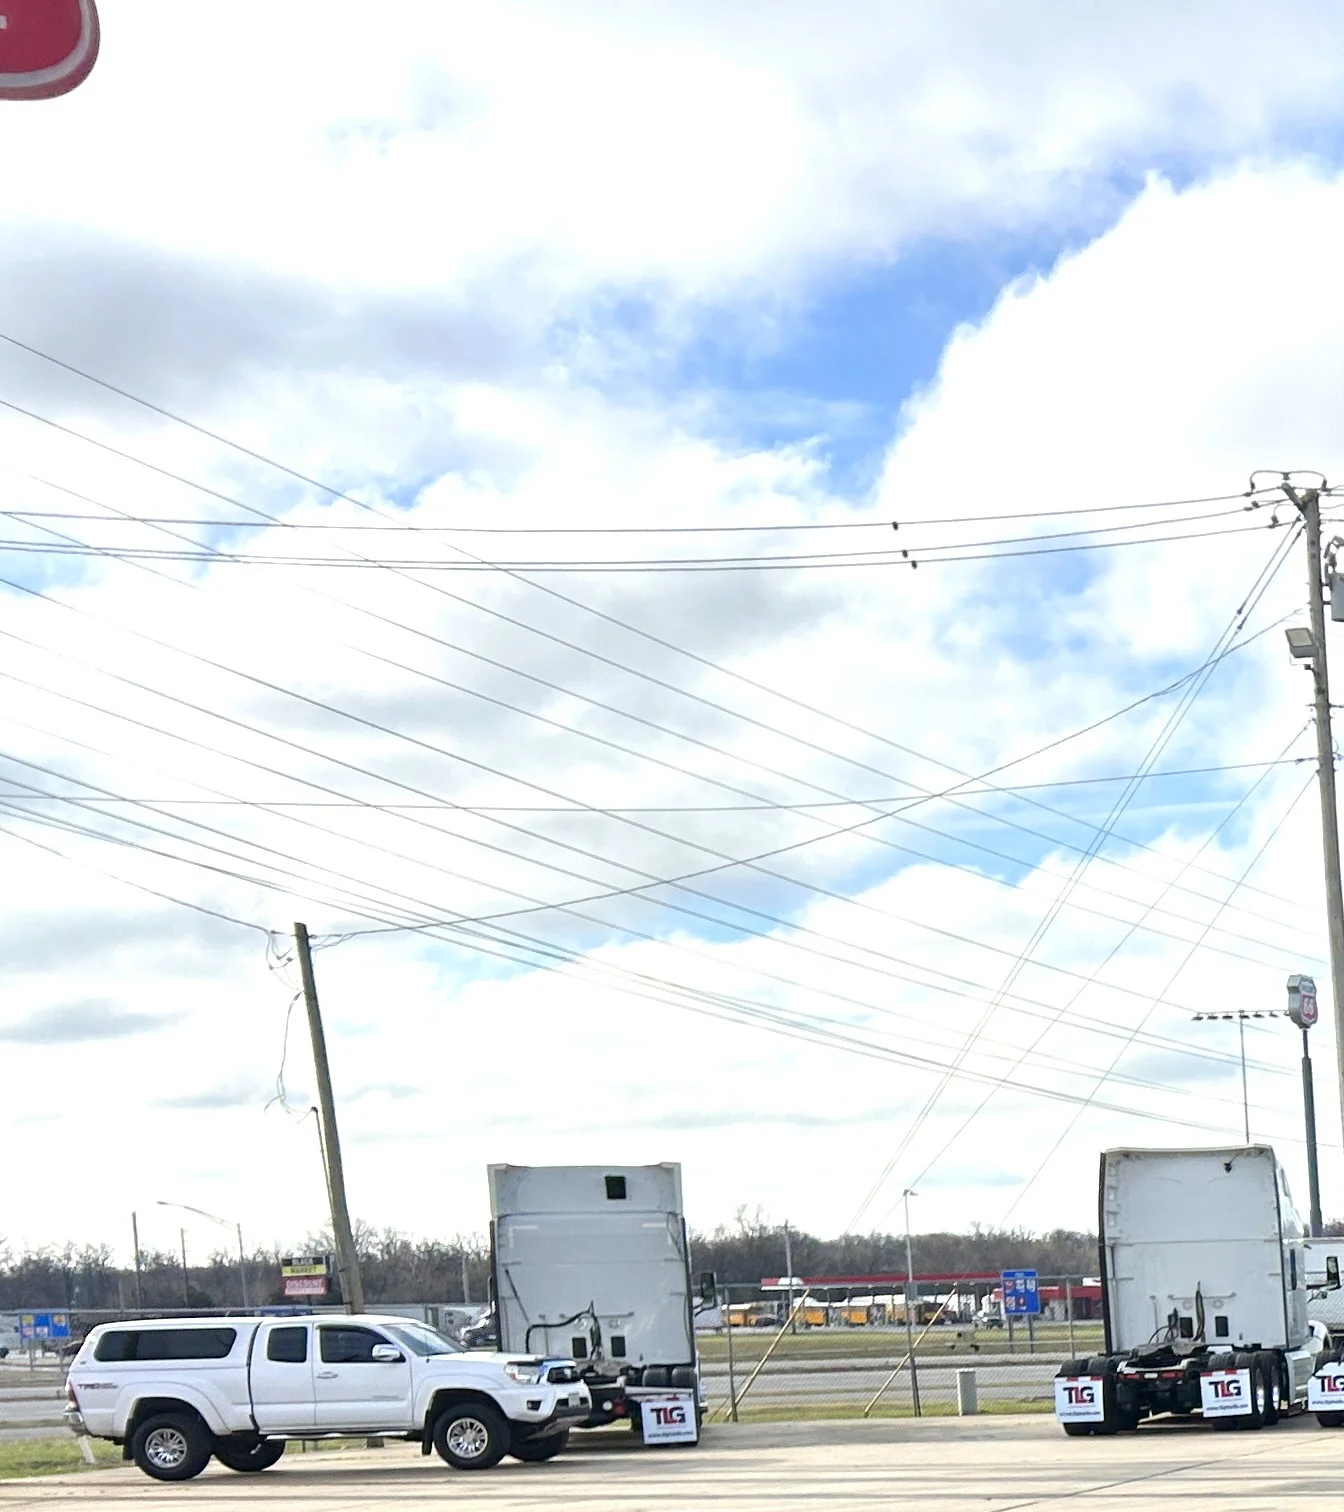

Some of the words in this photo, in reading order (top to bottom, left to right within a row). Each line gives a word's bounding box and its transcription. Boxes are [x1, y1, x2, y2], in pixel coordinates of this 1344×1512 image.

[1063, 1386, 1095, 1404] TLG
[1208, 1379, 1242, 1398] TLG
[650, 1406, 686, 1425] TLG
